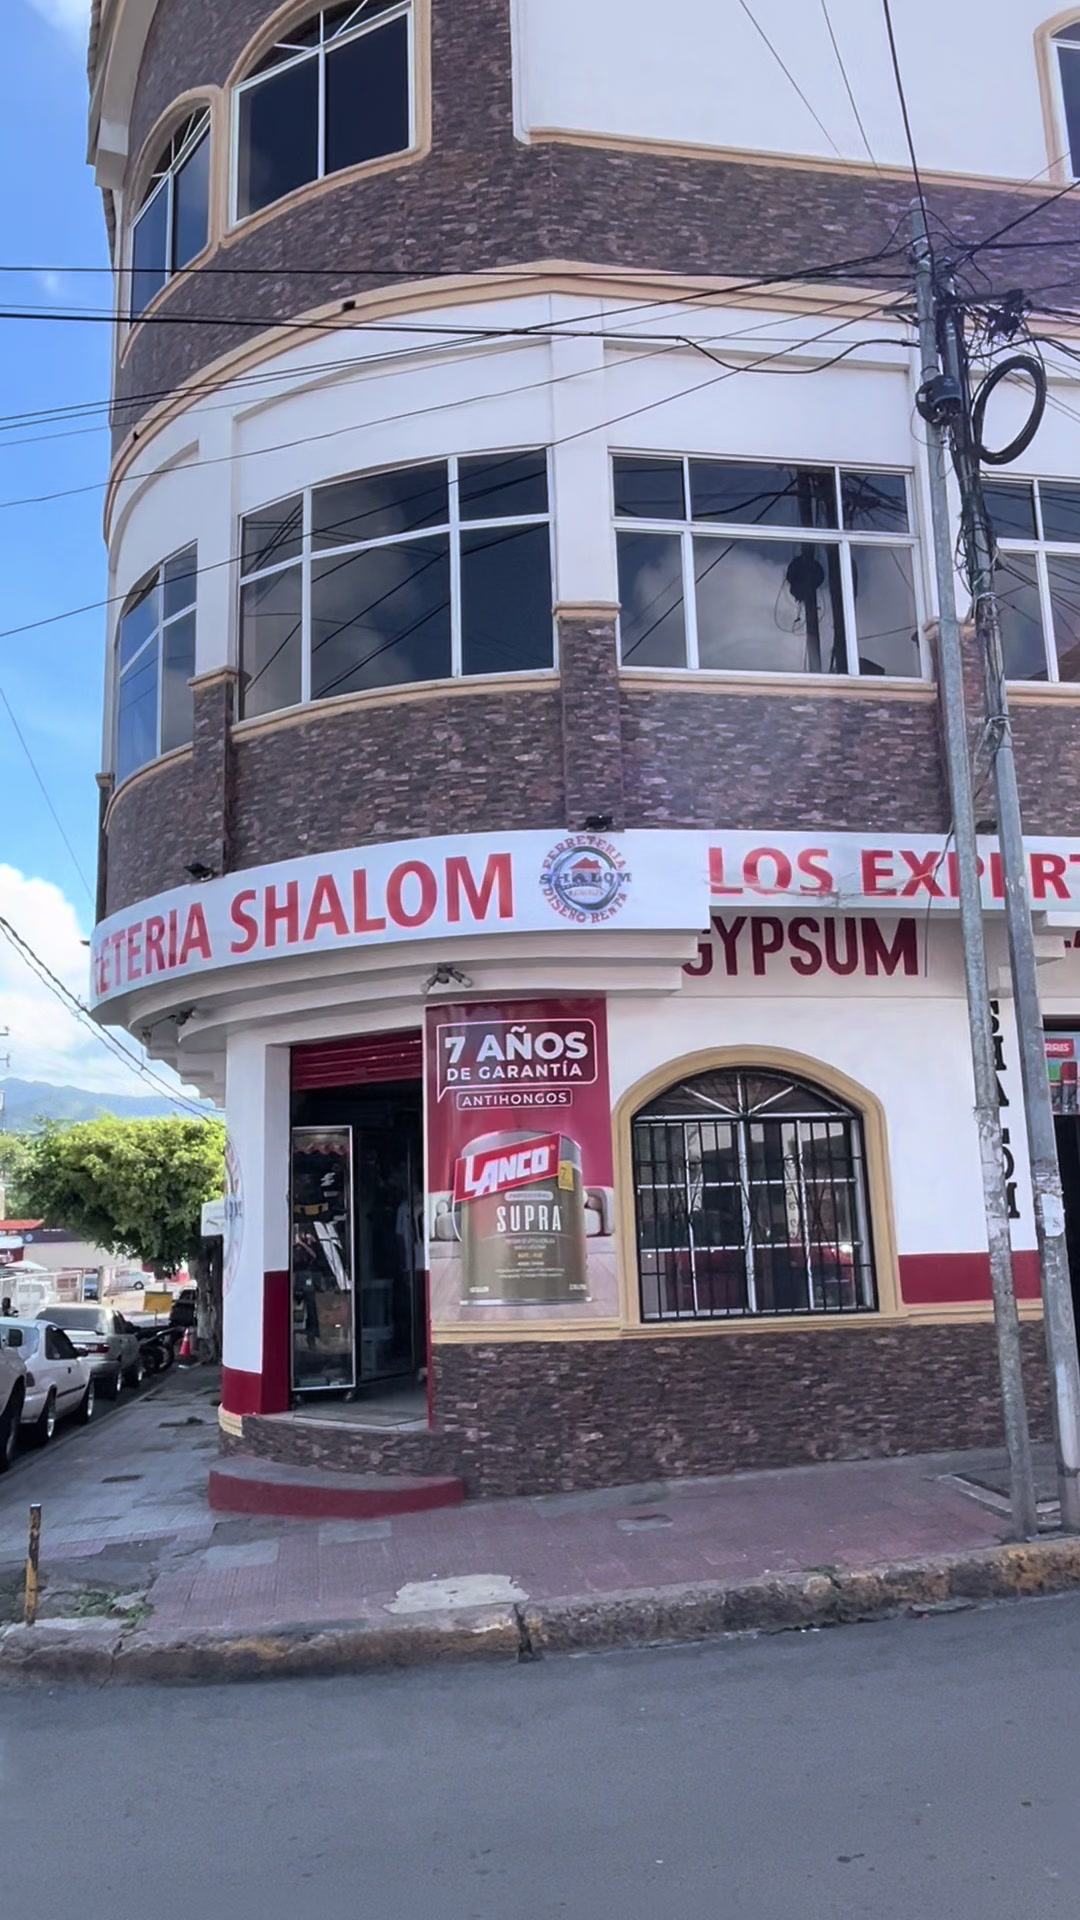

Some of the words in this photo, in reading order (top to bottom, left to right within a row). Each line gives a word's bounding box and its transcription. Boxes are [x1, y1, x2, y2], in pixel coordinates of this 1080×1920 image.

[539, 871, 632, 885] SHALOM
[708, 846, 834, 895] LOS
[861, 849, 1080, 899] EXPR
[96, 902, 212, 995] ETERIA
[230, 852, 514, 954] SHALOM
[445, 1036, 466, 1064] 7
[476, 1025, 588, 1062] AÑOS
[447, 1067, 471, 1081] DE
[479, 1060, 583, 1080] GARANTÍA
[462, 1092, 567, 1107] ANTIHONGOS
[464, 1145, 550, 1198] LANCO
[497, 1204, 562, 1233] SUPRA
